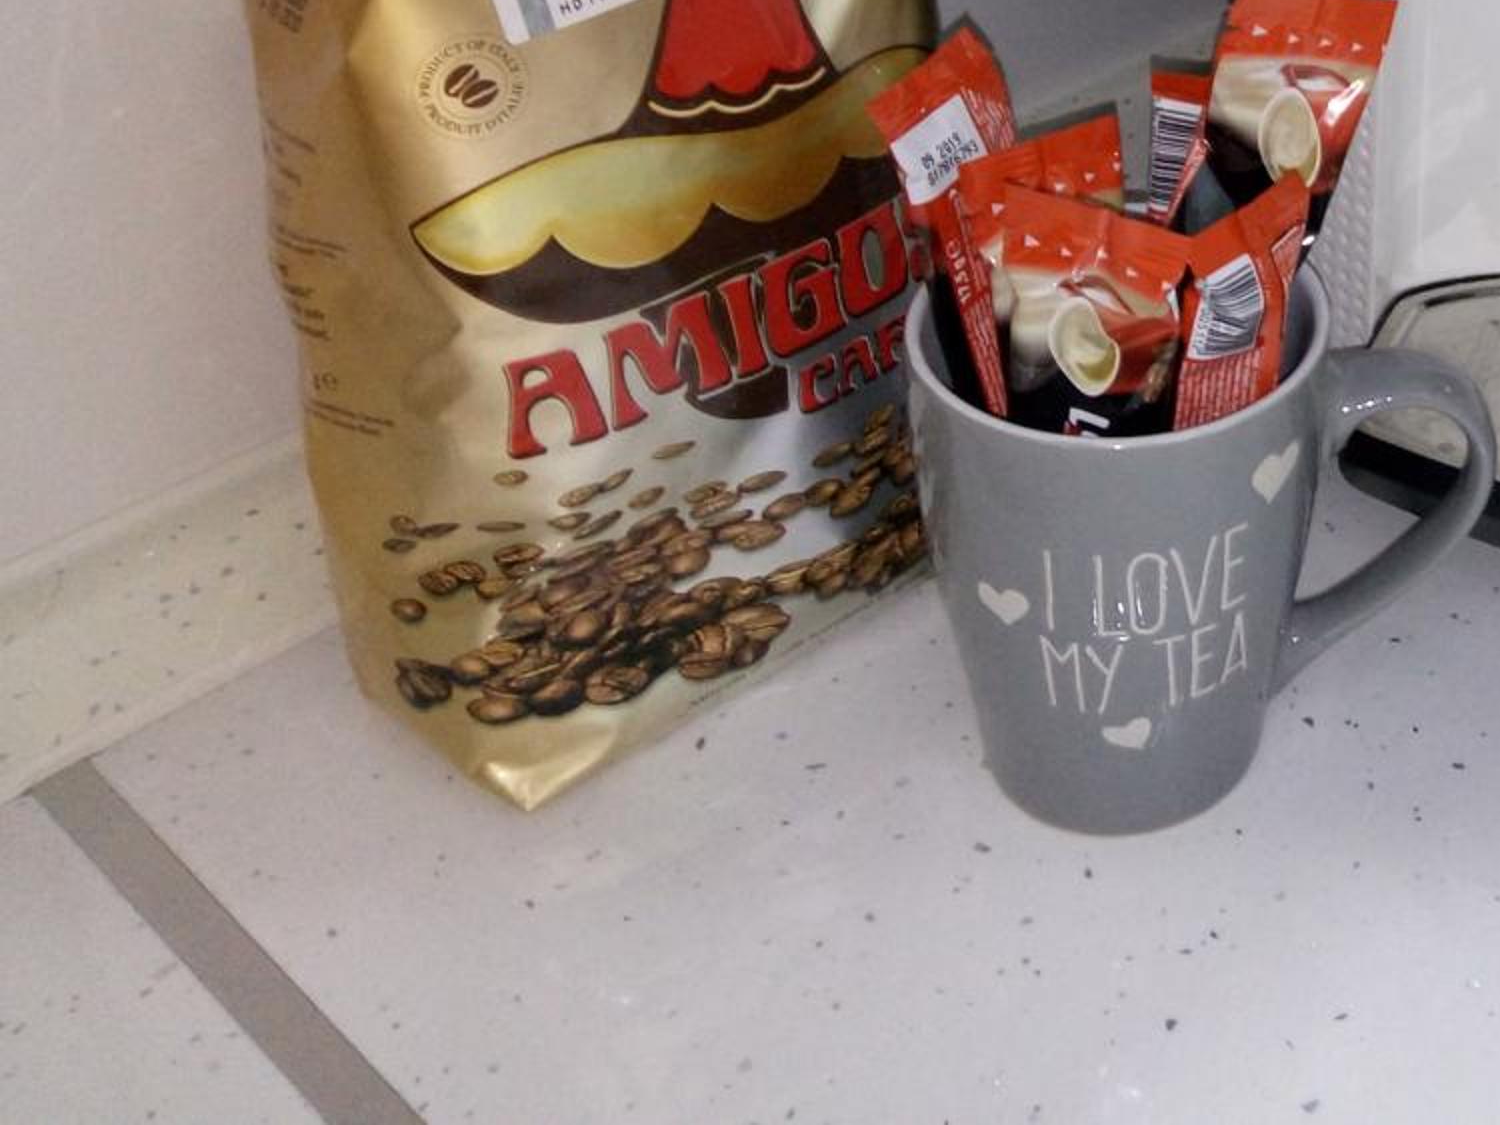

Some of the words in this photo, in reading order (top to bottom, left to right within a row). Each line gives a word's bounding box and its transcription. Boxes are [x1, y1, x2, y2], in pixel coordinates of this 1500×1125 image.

[503, 200, 933, 460] AMIGO
[1043, 549, 1055, 631] I
[1093, 522, 1249, 637] LOVE
[1039, 635, 1125, 713] MY
[1153, 612, 1248, 707] TEA
